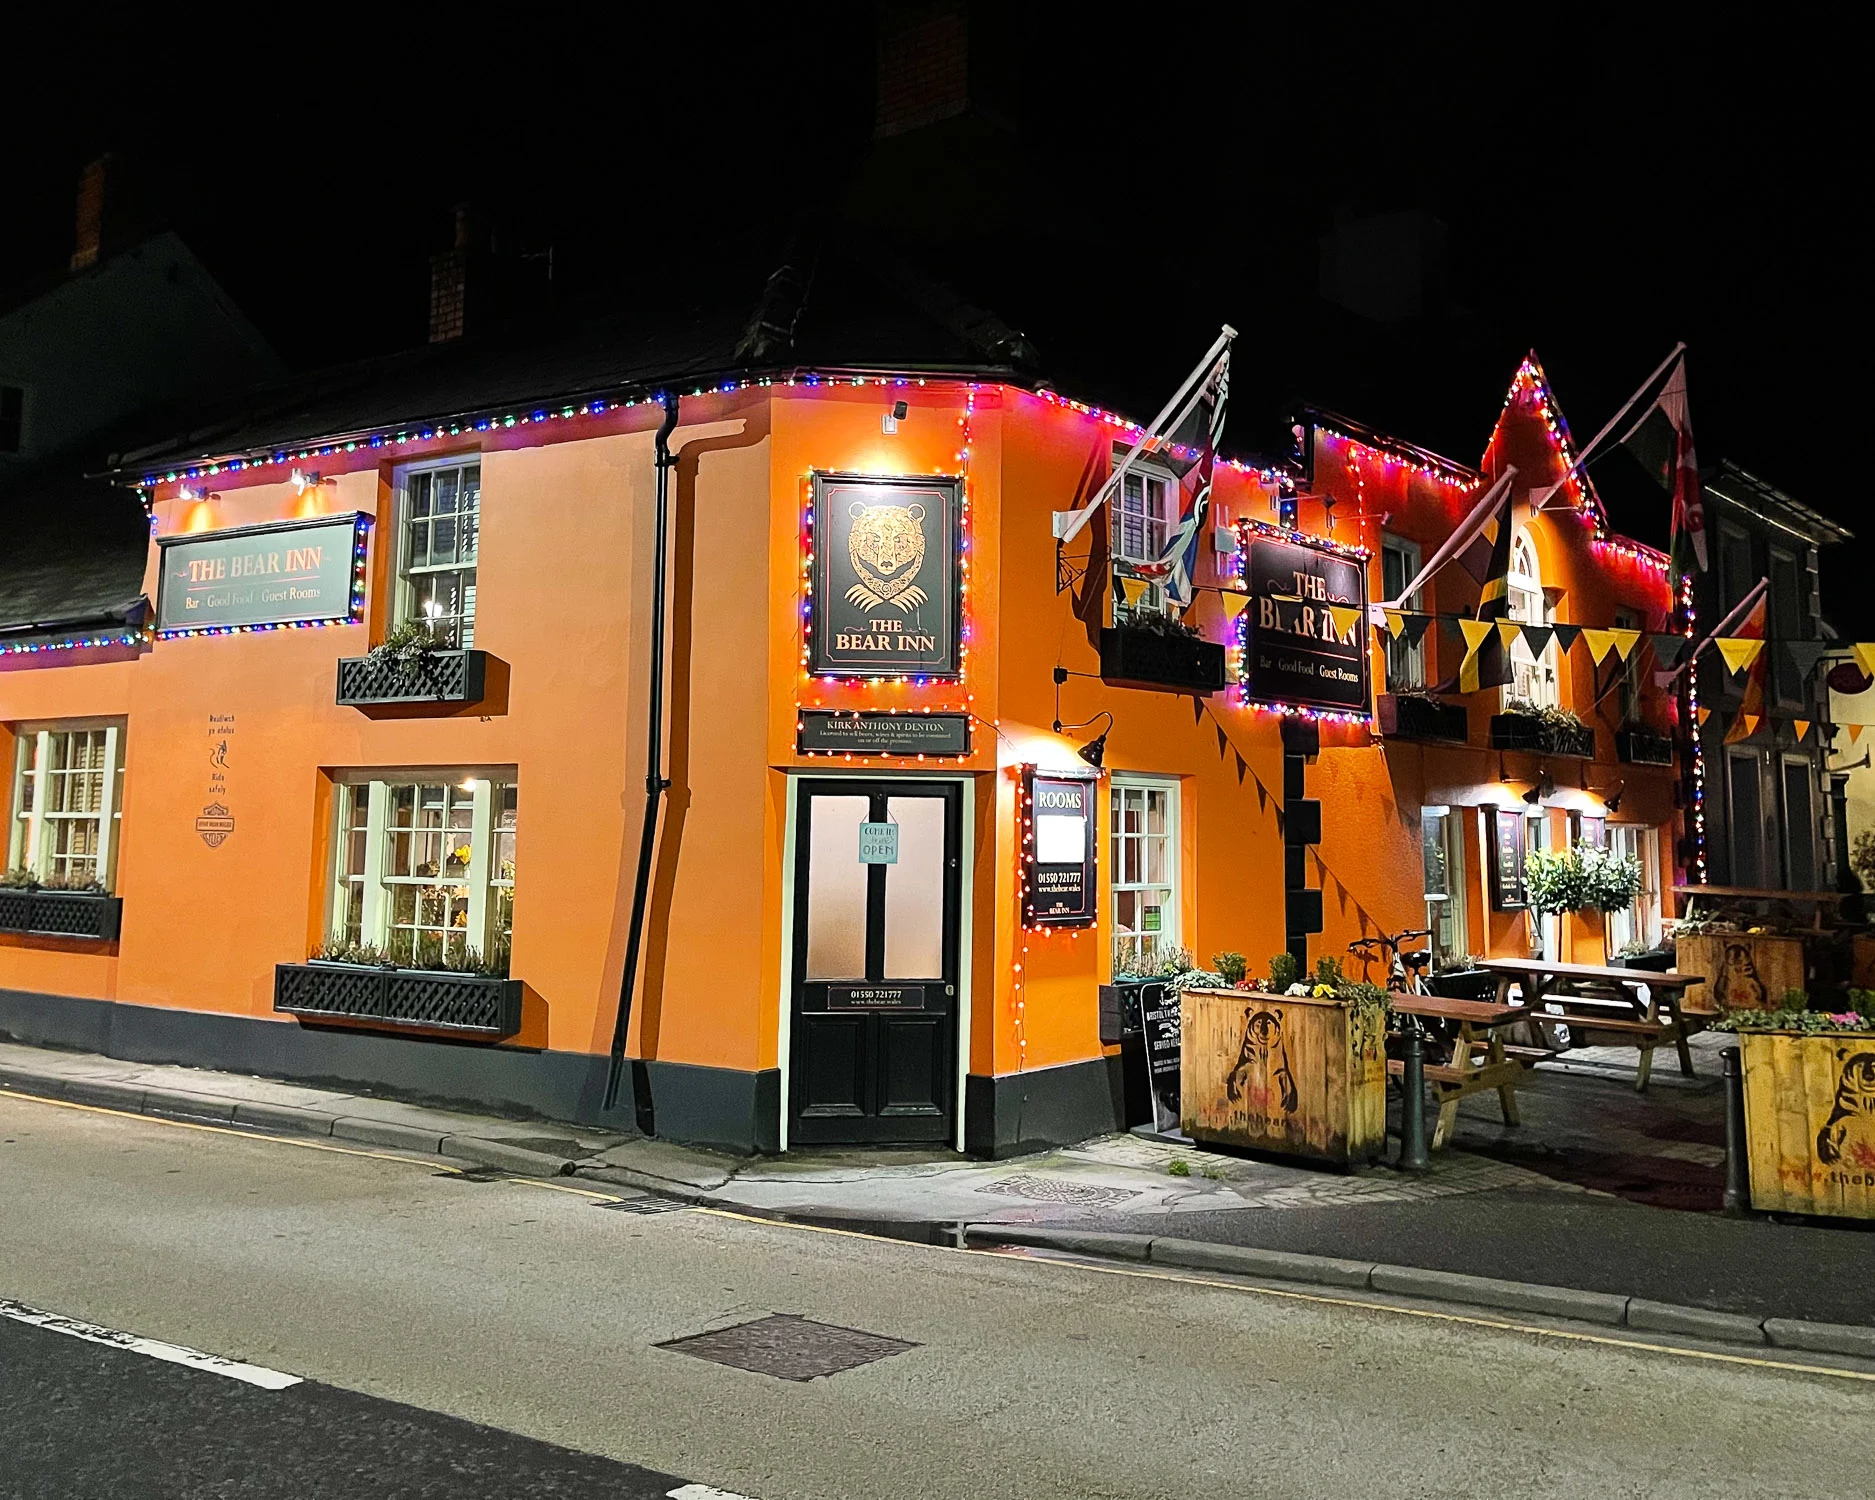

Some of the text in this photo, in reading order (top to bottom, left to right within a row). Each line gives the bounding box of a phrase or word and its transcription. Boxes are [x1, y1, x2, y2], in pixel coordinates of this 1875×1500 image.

[189, 546, 322, 582] THE BEAR INN
[1293, 571, 1326, 602] THE
[185, 586, 321, 610] Bar Good Food Guest Rooms
[868, 619, 903, 633] THE
[1260, 596, 1318, 639] BR
[835, 633, 936, 652] BEAR INN
[1260, 655, 1359, 683] Bar Good Food Guest Rooms
[827, 721, 945, 732] KIRK ANTHONY DENTON
[1038, 791, 1082, 809] ROOMS
[863, 845, 894, 856] OPEN
[1038, 872, 1081, 883] 01550 721777
[850, 990, 902, 998] 01550 721777
